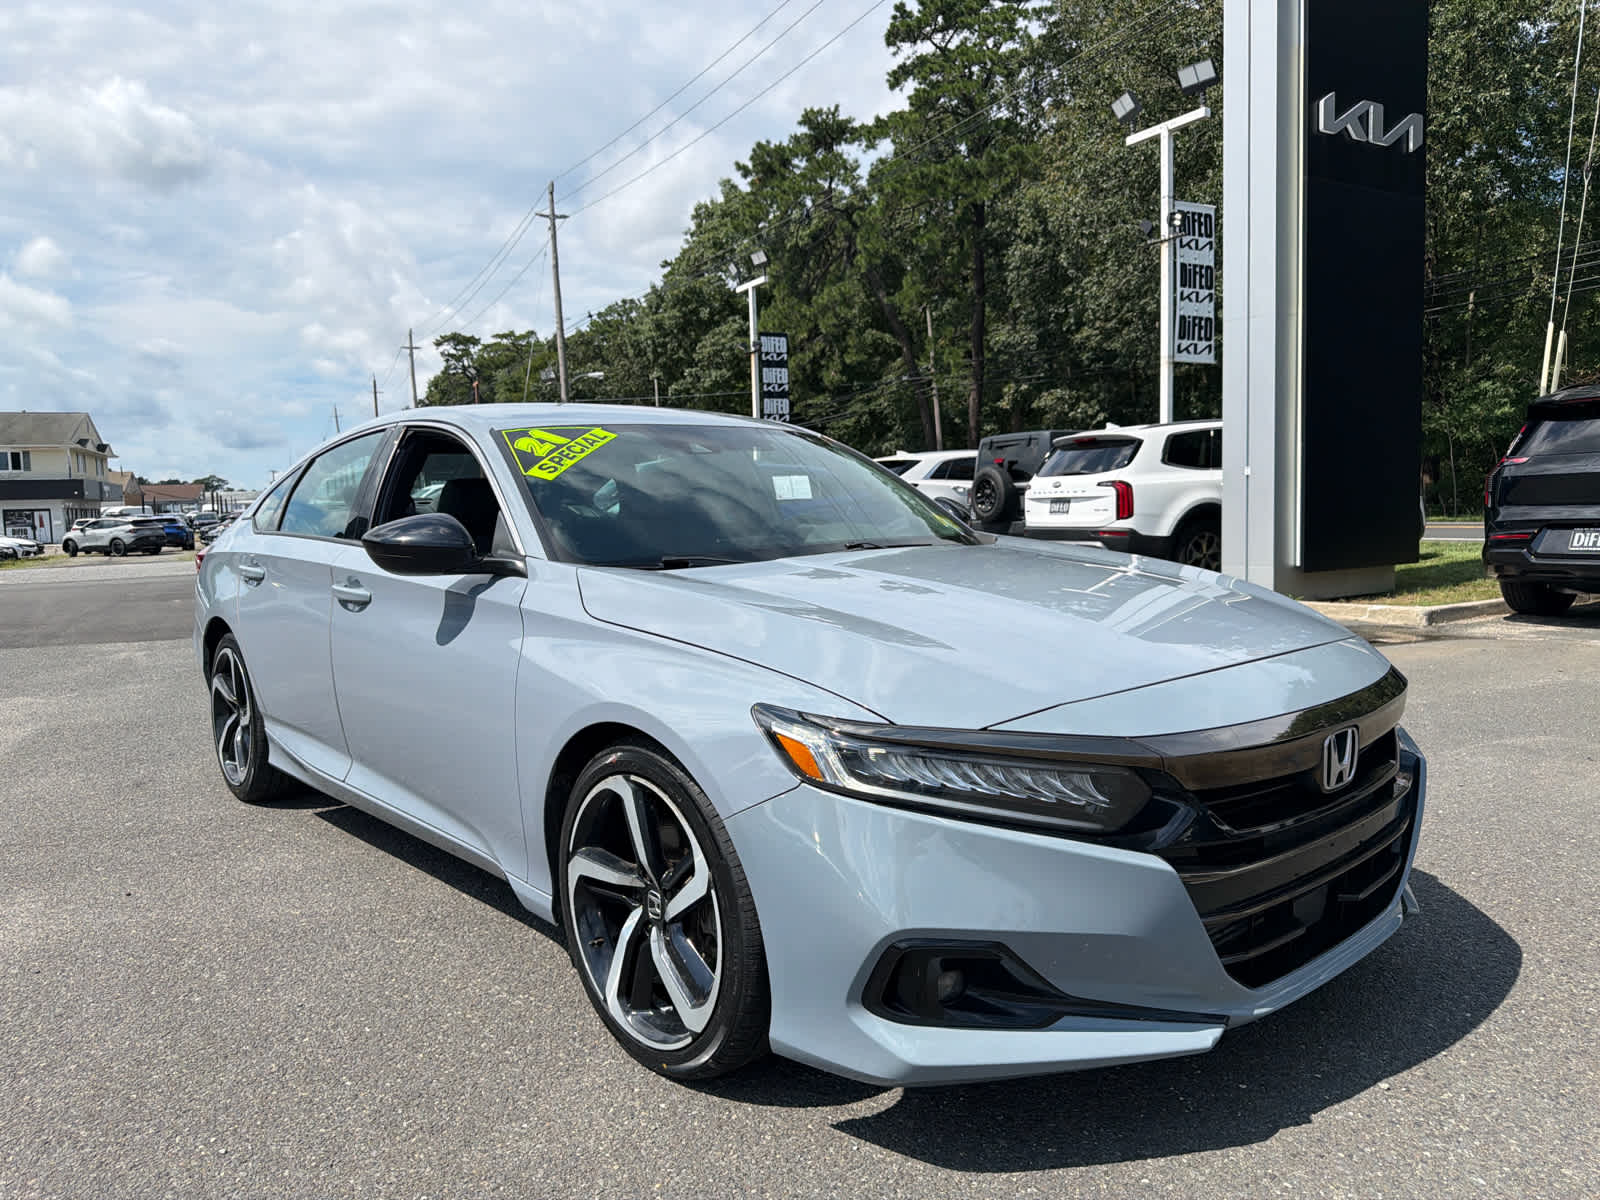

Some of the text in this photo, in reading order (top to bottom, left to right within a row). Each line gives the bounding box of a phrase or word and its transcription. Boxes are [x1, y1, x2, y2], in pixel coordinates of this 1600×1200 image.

[1318, 91, 1424, 153] KIA
[1180, 238, 1214, 251] KIA
[1180, 263, 1214, 290] DiFEO
[1180, 290, 1214, 303] KIA
[1178, 315, 1213, 342] DiFEO
[1177, 342, 1213, 355] KIA
[514, 429, 572, 457] 21
[538, 432, 609, 474] SPECIAL
